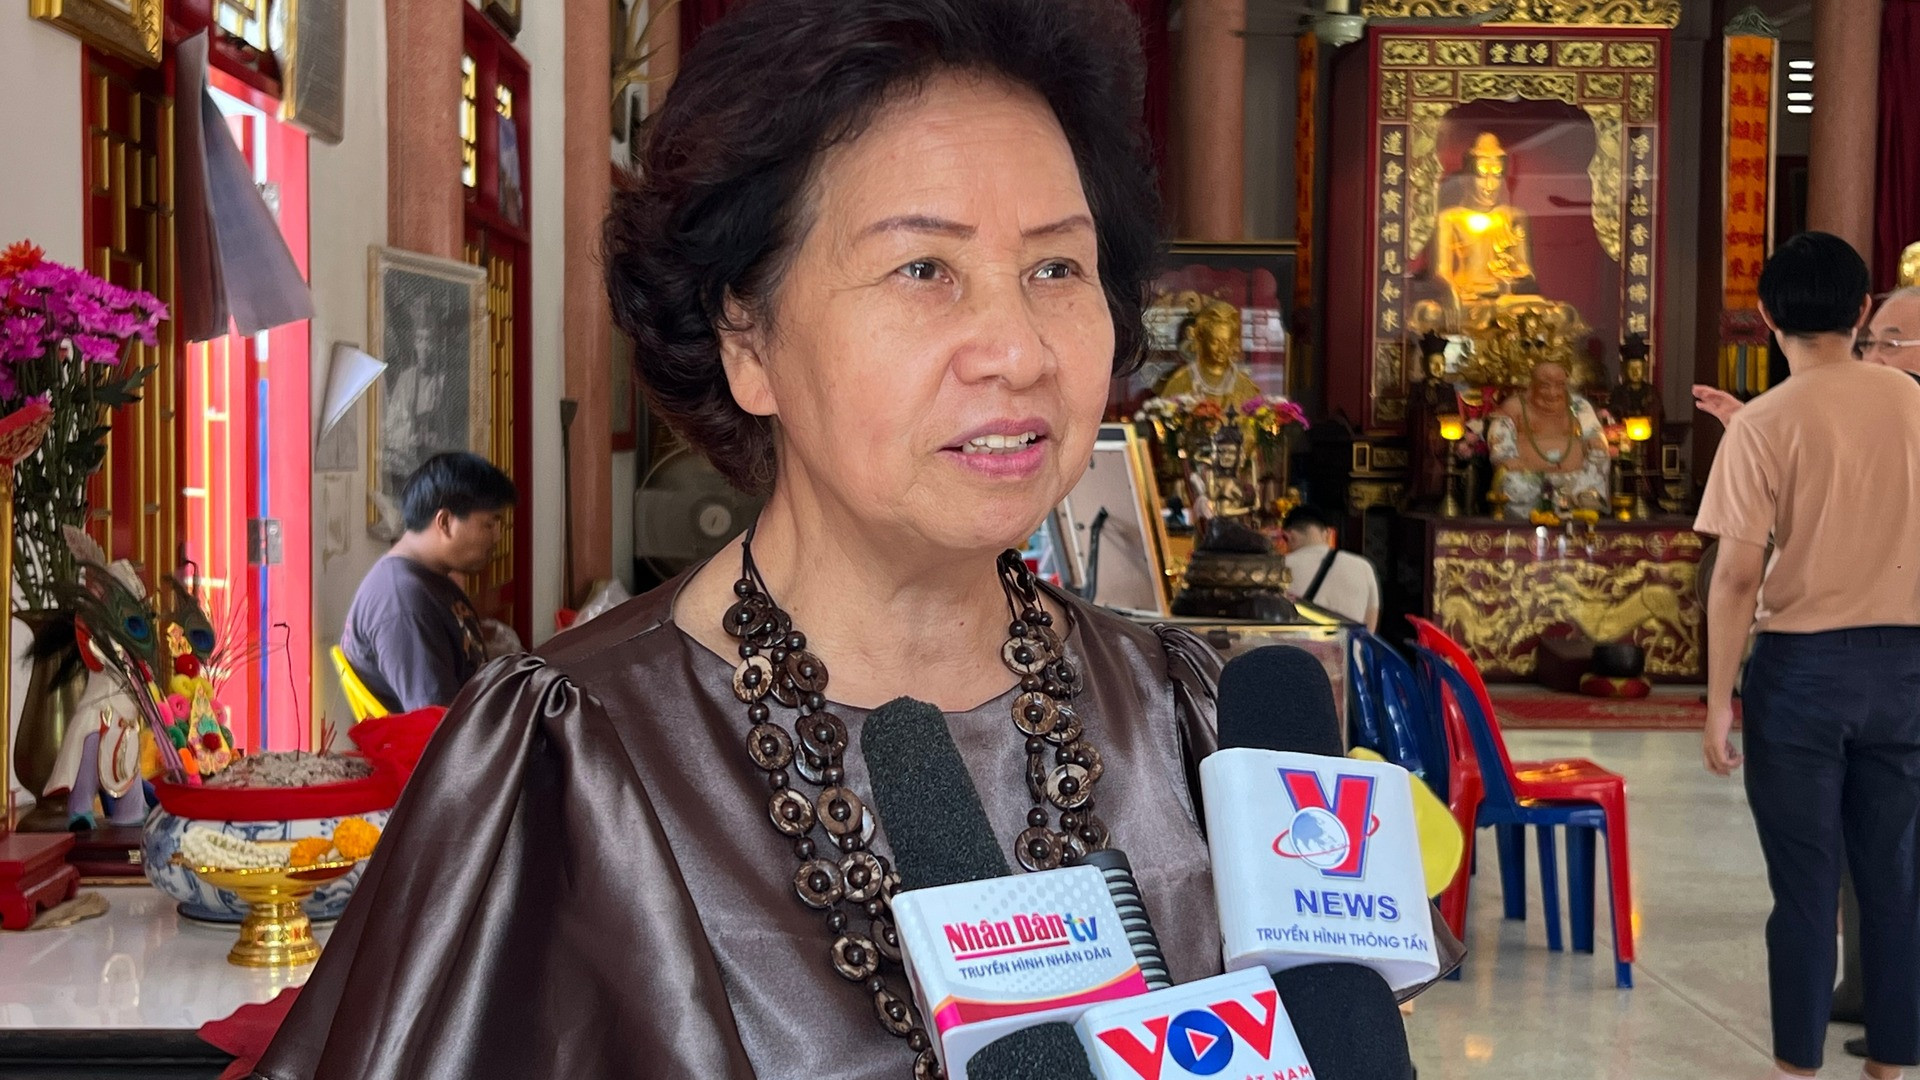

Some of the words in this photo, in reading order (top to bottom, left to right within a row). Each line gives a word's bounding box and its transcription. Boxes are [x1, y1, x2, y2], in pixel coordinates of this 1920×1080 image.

[1294, 888, 1399, 920] NEWS
[943, 919, 1016, 953] Nhân
[1012, 912, 1067, 943] Dân
[1063, 912, 1098, 942] tv
[1256, 924, 1309, 942] TRUYỀN
[1313, 927, 1347, 945] HÌNH
[1350, 932, 1400, 948] THÔNG
[1402, 933, 1428, 951] TẤN
[1011, 955, 1045, 974] HÌNH
[1044, 949, 1083, 967] NHÂN
[1083, 946, 1112, 961] DÂN
[1096, 989, 1277, 1080] VOV
